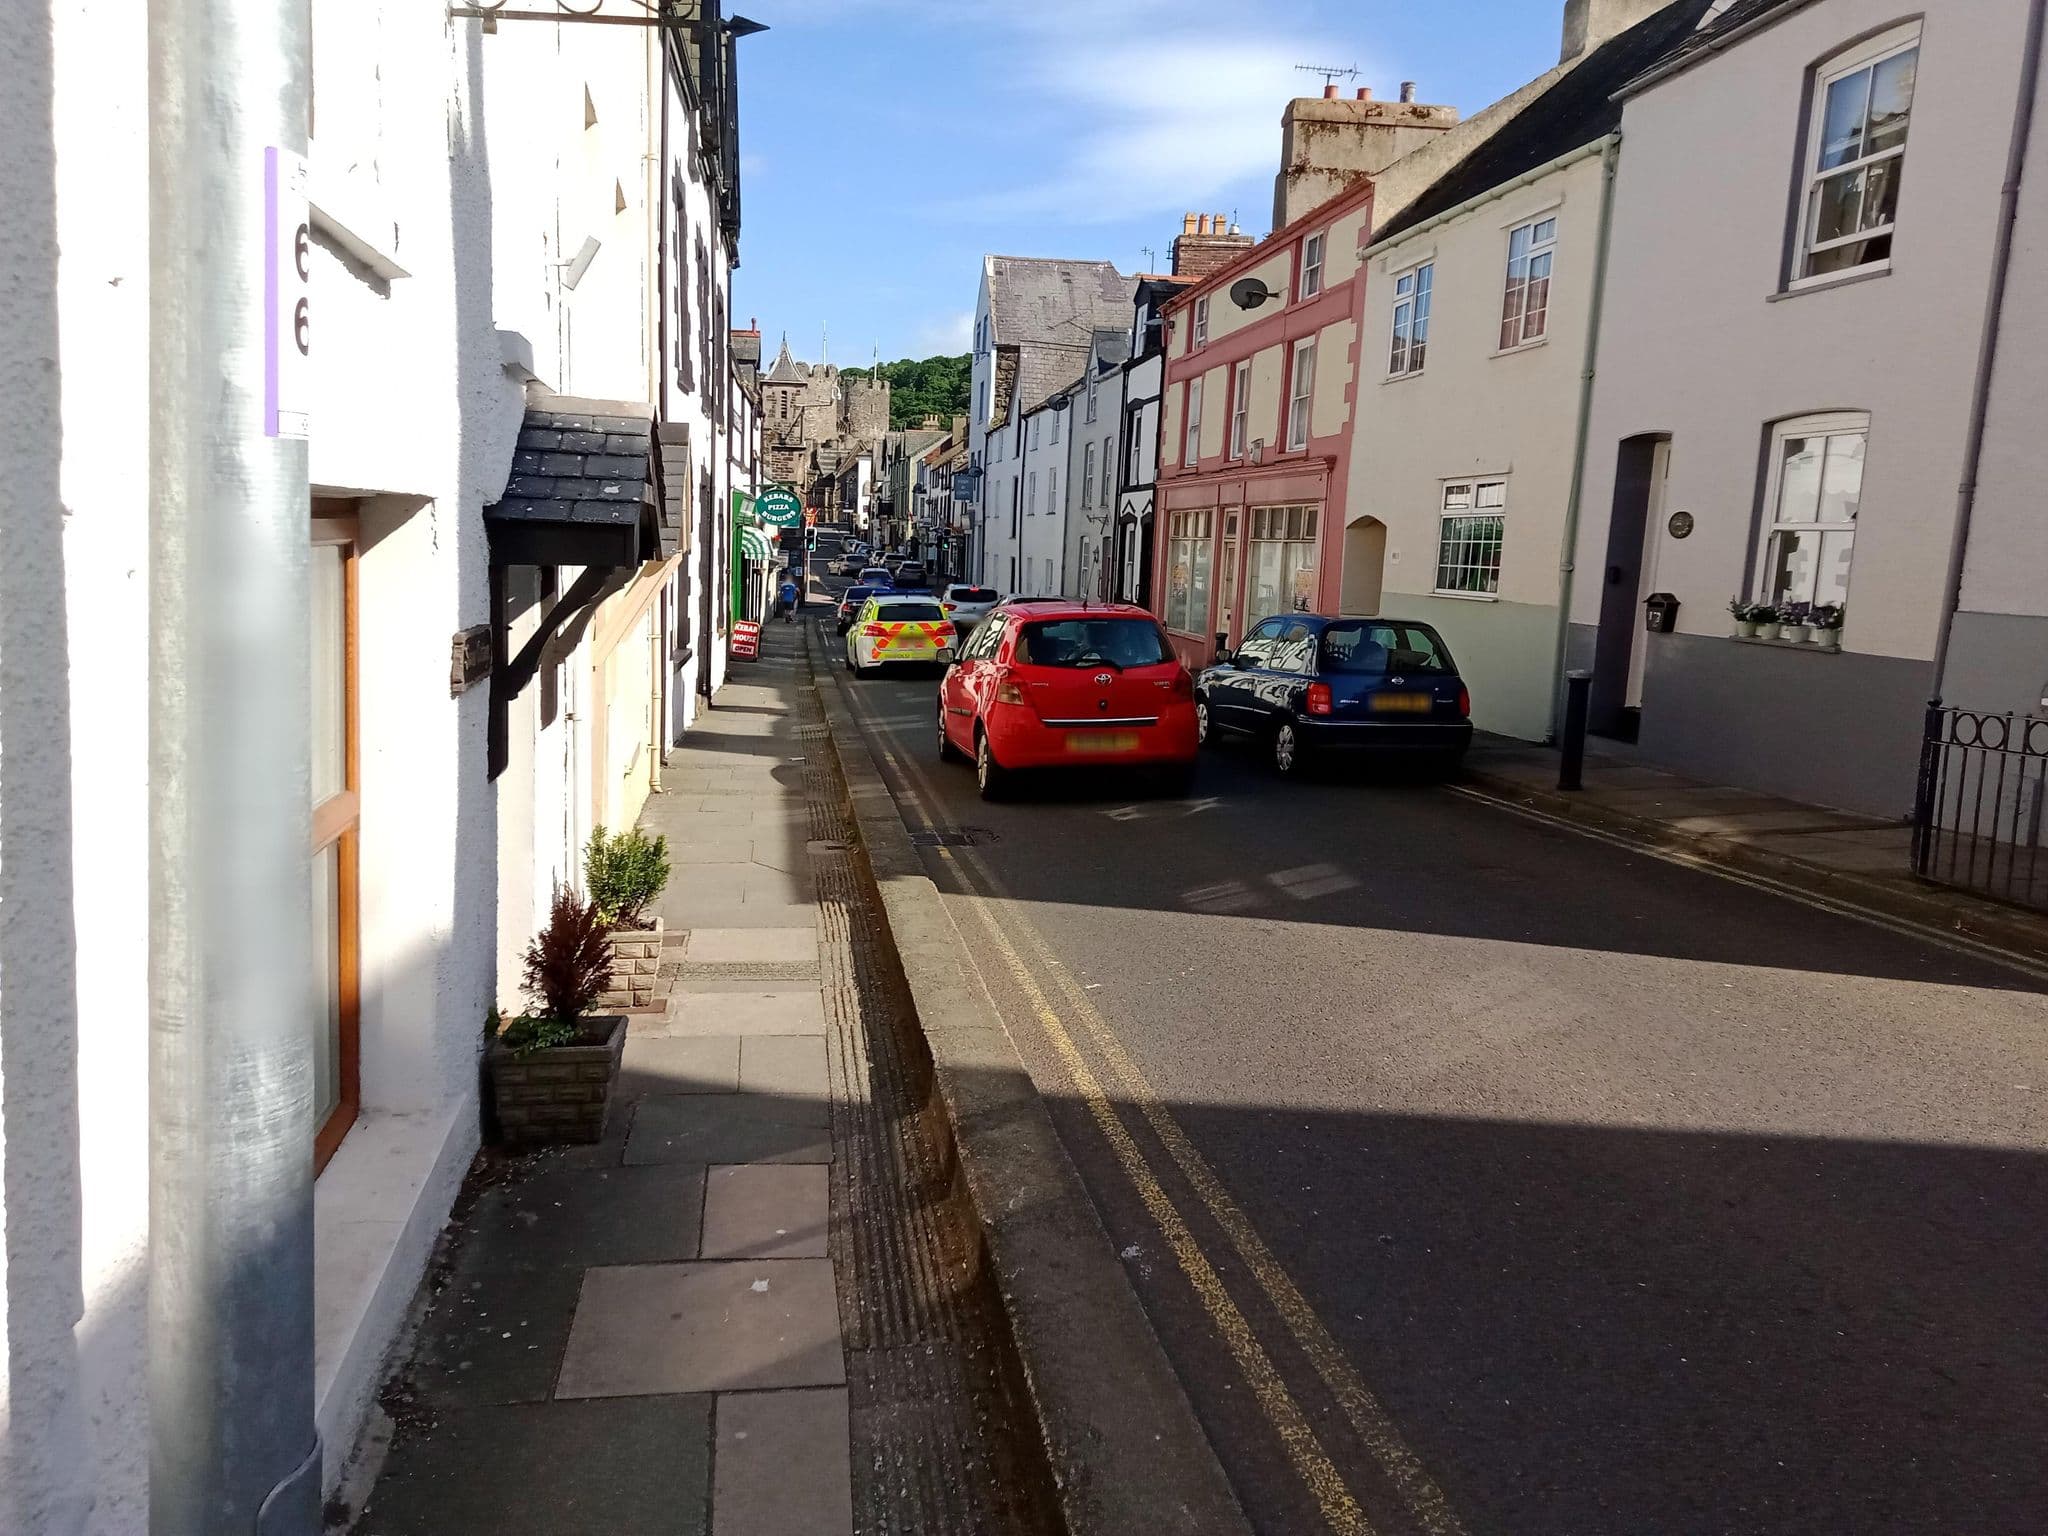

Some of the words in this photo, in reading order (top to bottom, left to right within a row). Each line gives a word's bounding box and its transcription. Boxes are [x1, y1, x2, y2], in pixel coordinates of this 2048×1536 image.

[763, 494, 794, 503] KEBABS
[762, 510, 795, 521] BURGERS
[735, 623, 757, 633] KEBAB
[734, 634, 756, 643] HOUSE
